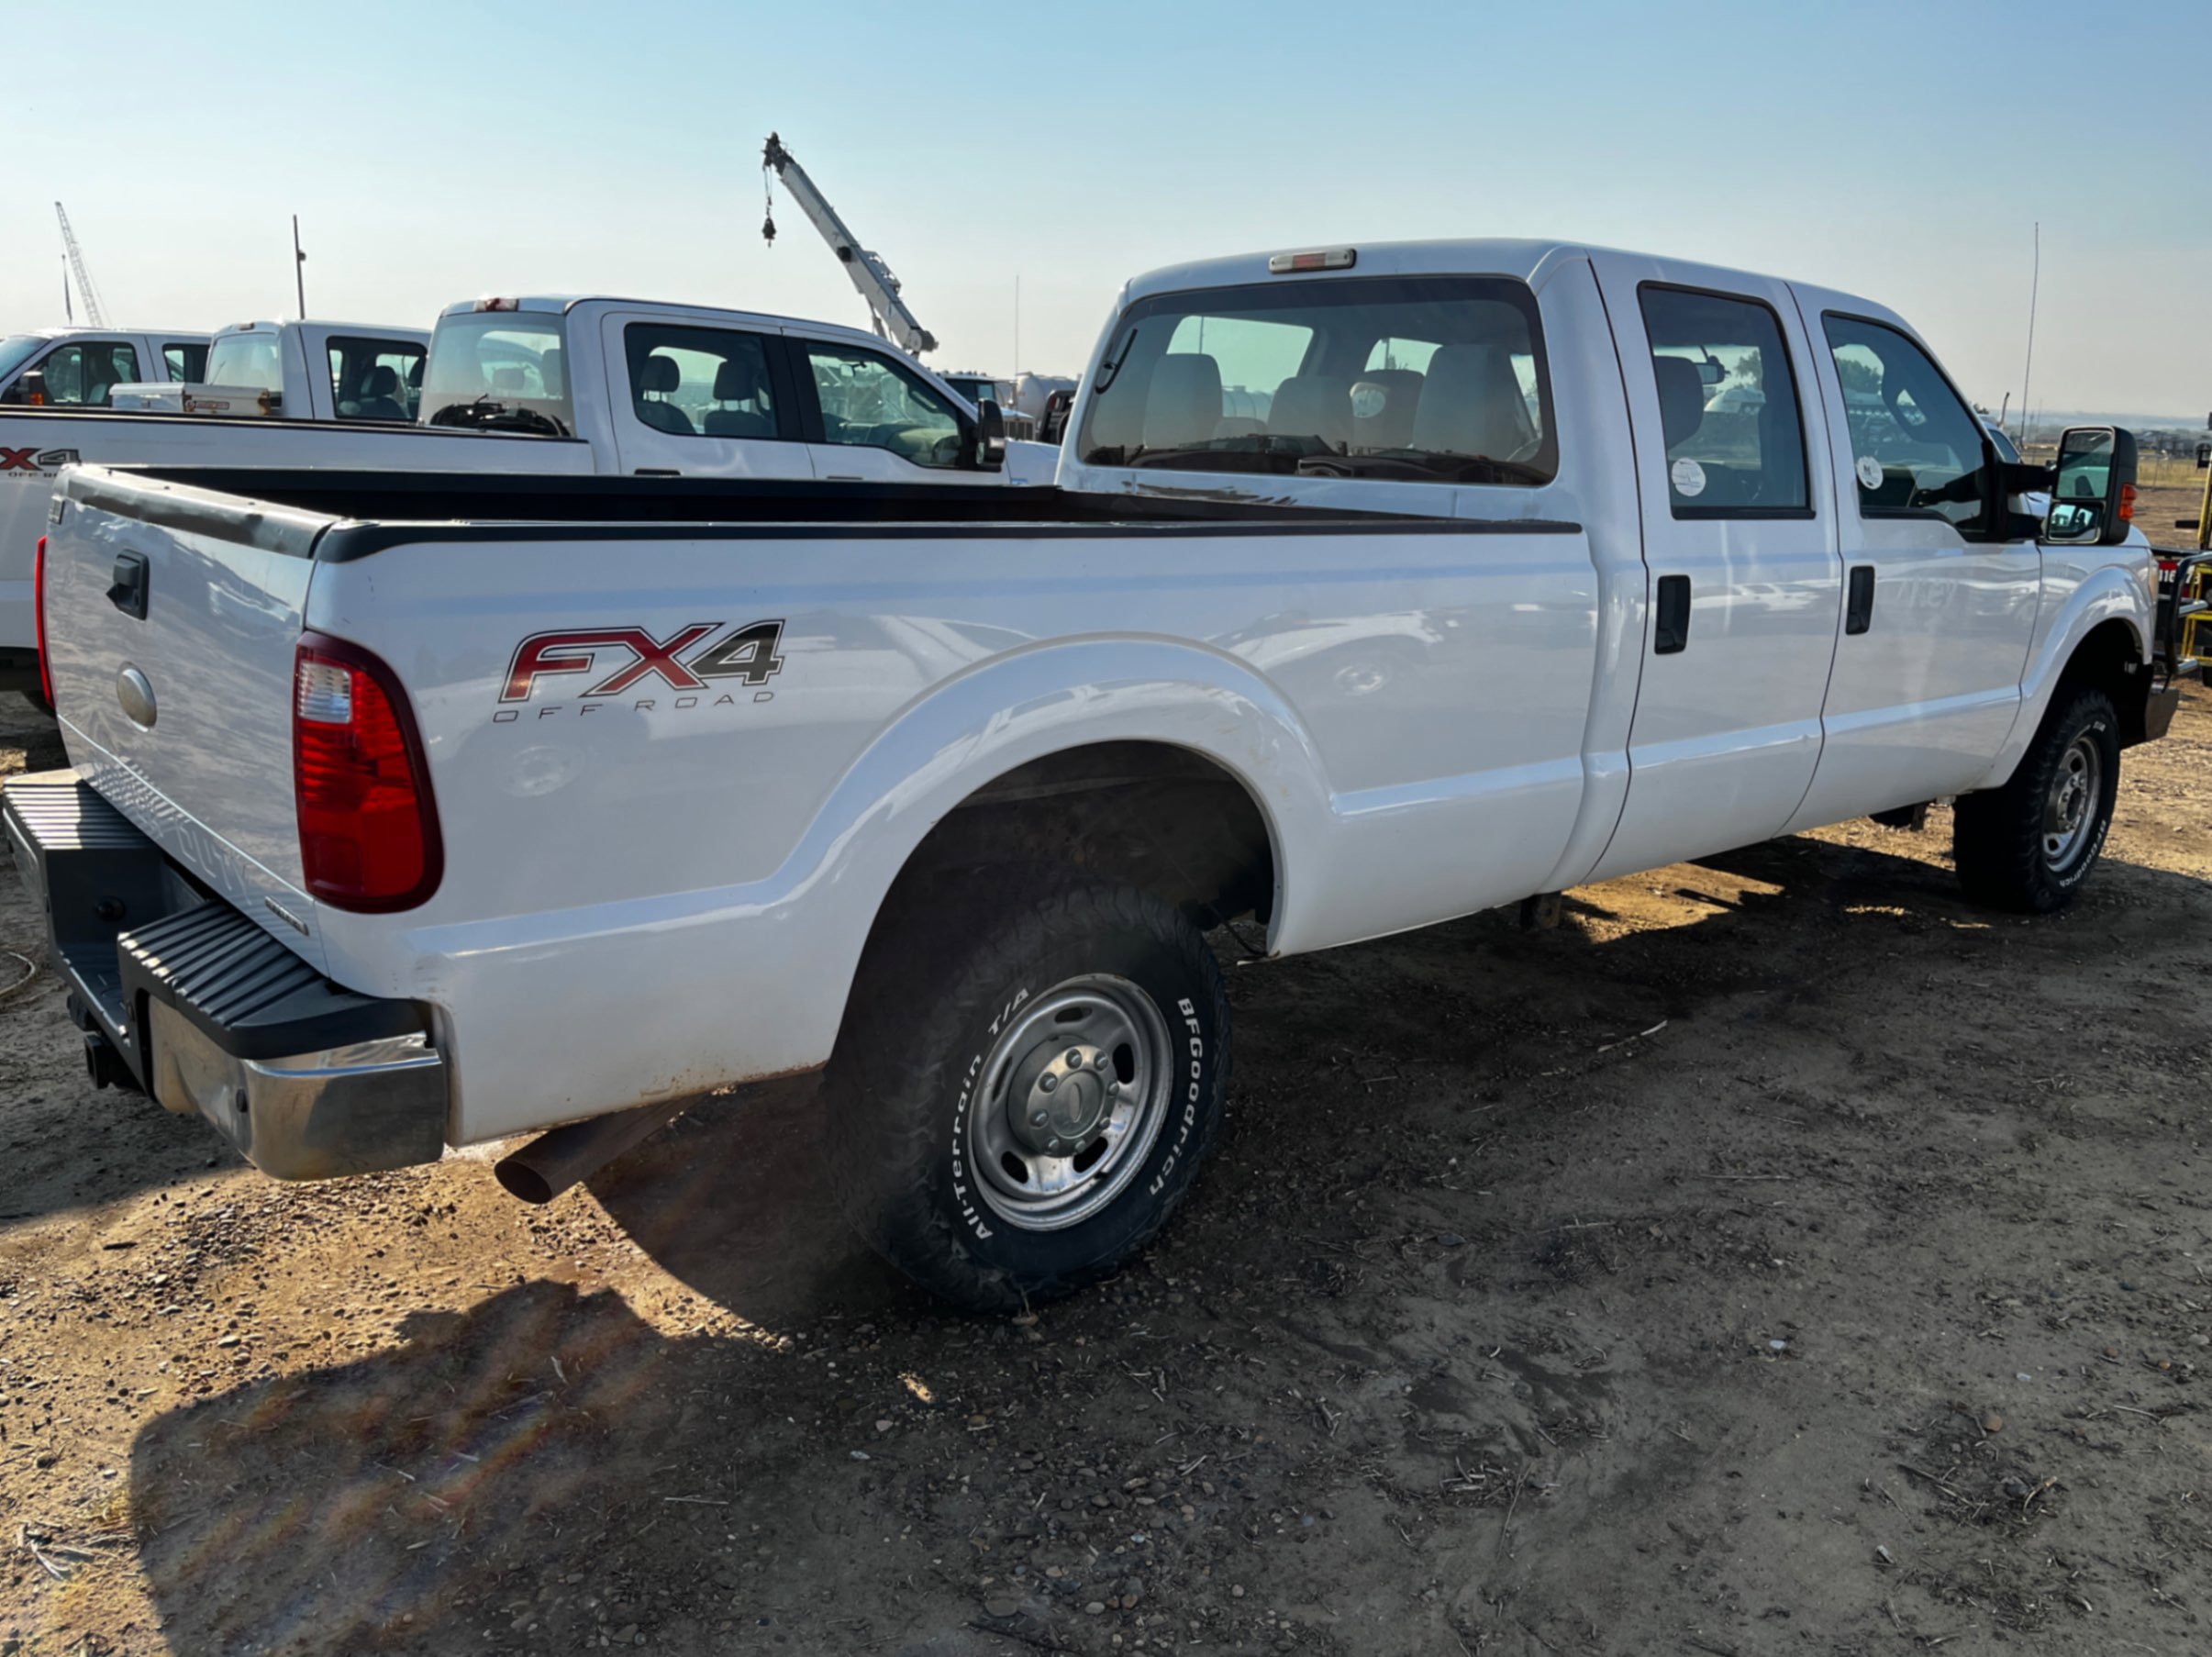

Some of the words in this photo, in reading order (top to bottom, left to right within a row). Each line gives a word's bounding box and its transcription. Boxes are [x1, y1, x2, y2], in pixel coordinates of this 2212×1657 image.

[493, 704, 604, 723] OFF
[634, 691, 775, 712] ROAD
[498, 619, 785, 703] FX4
[952, 1055, 993, 1240] All-Terrain
[988, 988, 1029, 1036] T/A
[1150, 997, 1203, 1196] BFGoodrich
